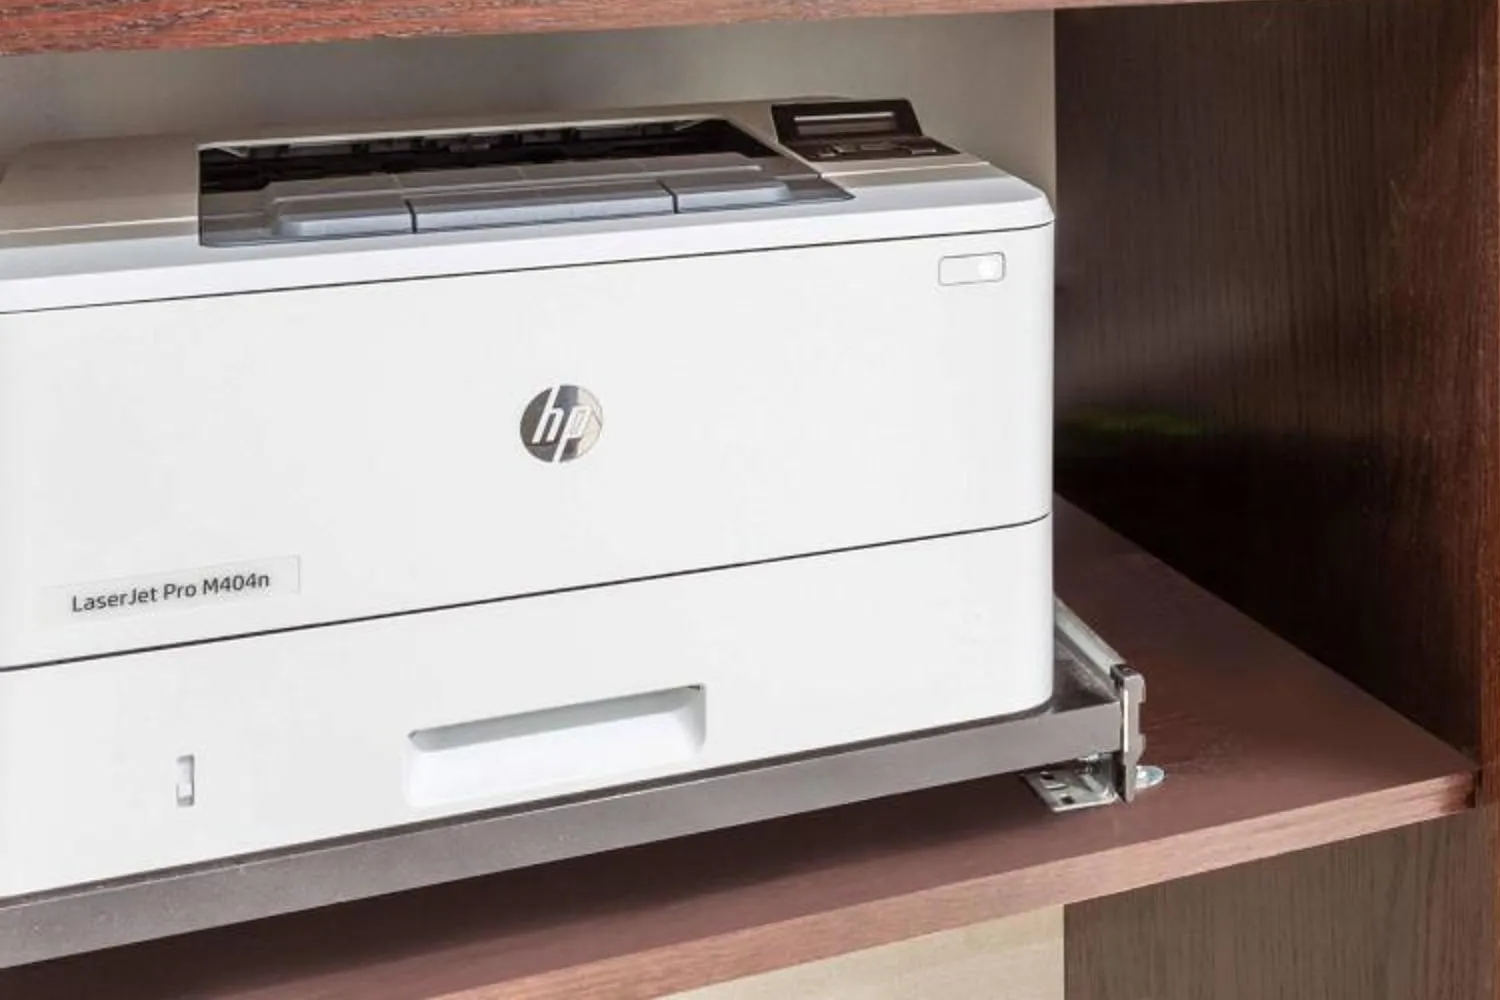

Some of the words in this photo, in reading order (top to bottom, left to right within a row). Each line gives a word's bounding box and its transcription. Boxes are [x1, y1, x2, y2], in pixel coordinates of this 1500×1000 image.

[530, 385, 594, 462] hp
[71, 587, 157, 613] LaserJet
[163, 583, 197, 601] Pro
[202, 572, 270, 596] M404n
